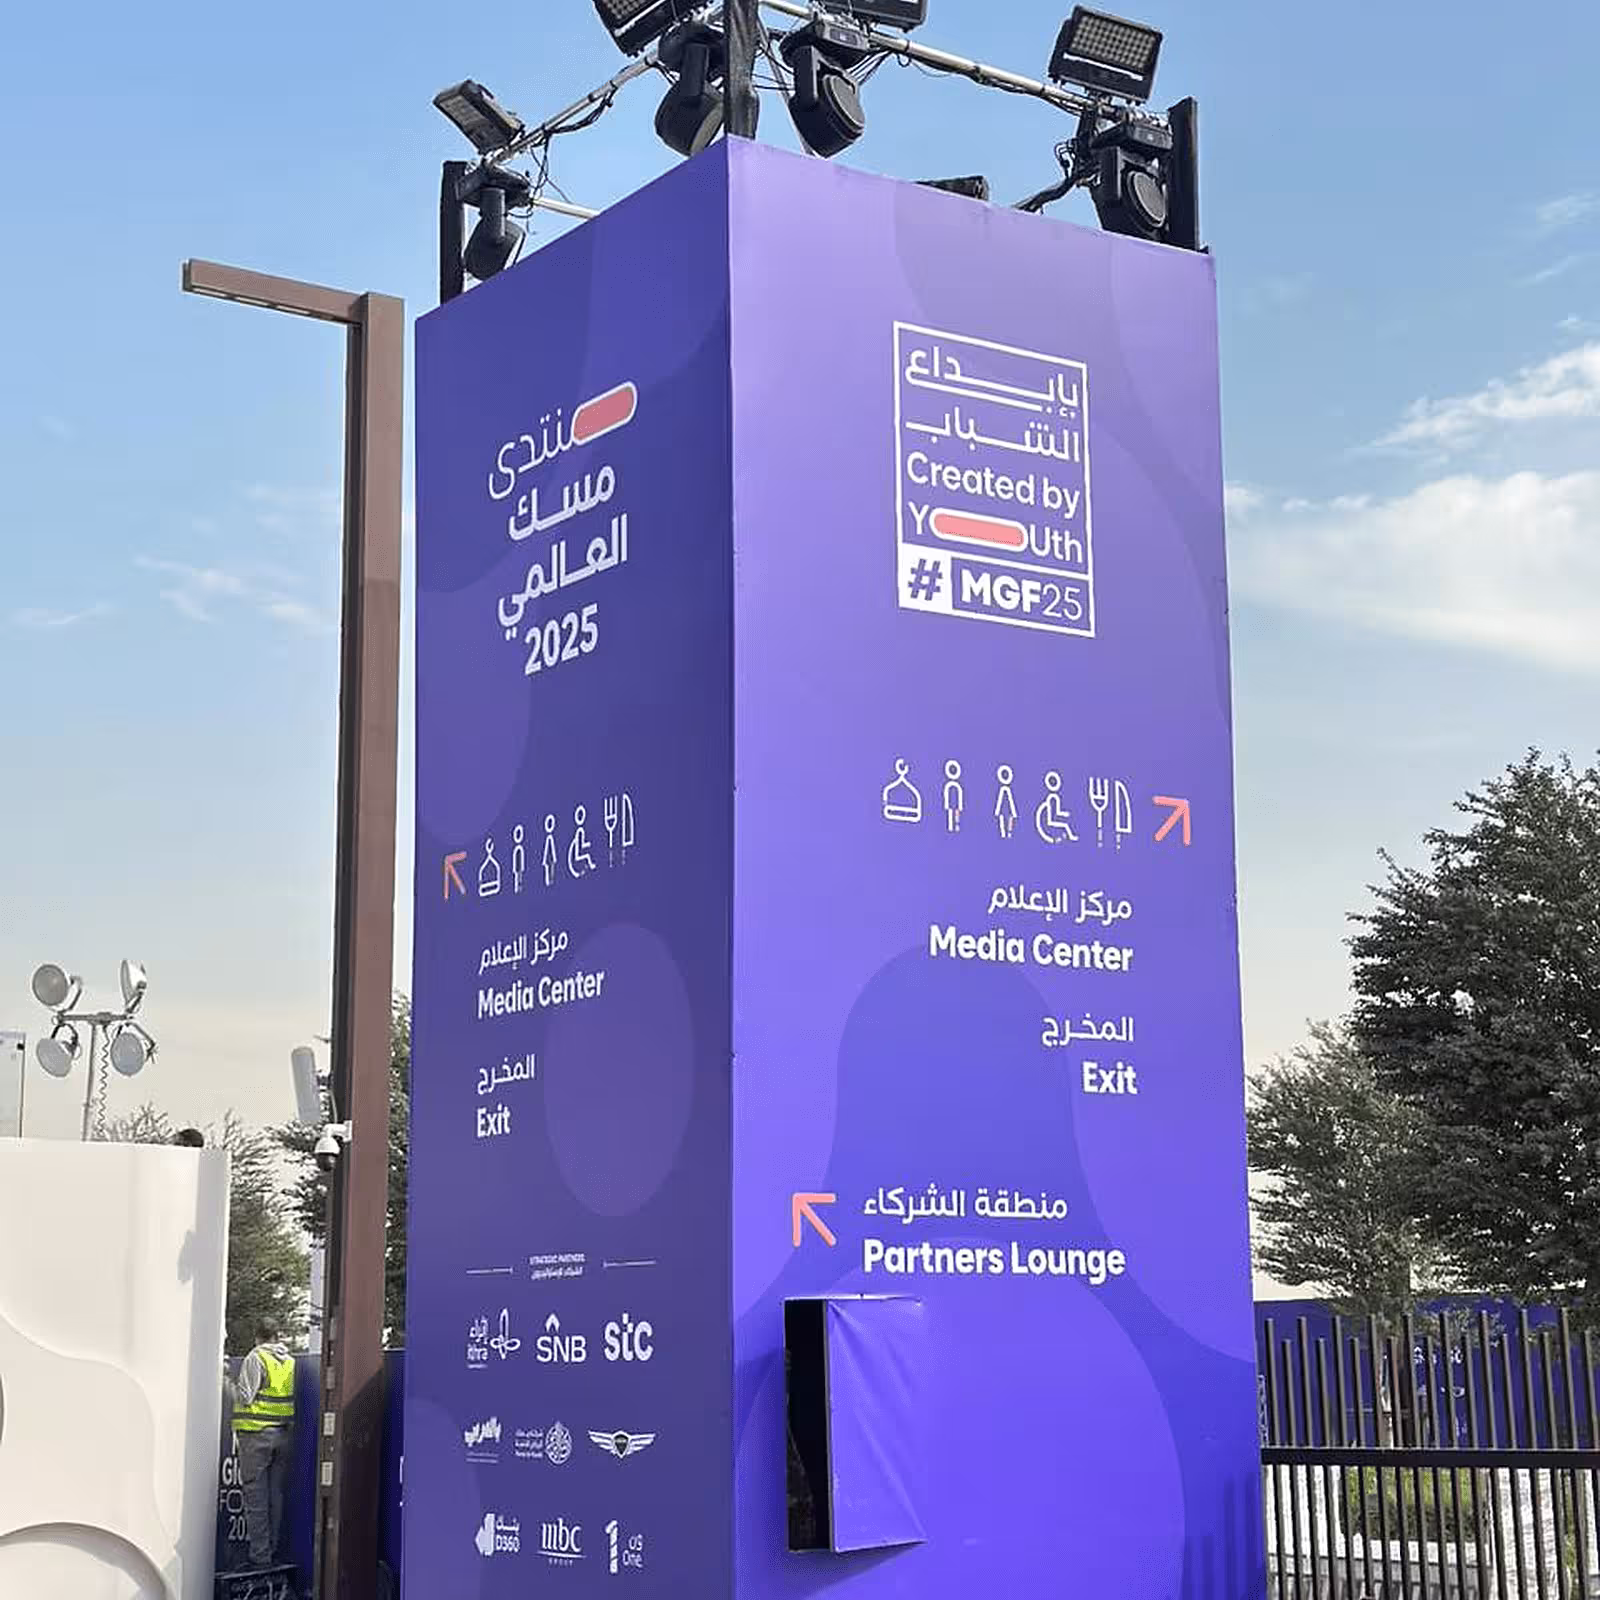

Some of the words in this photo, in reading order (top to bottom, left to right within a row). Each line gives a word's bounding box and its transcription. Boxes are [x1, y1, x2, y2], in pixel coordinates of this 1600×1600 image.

[906, 406, 1080, 463] الشباب
[508, 465, 615, 541] مسك
[906, 451, 1035, 505] Created
[1043, 477, 1080, 519] by
[498, 513, 628, 641] العالمي
[961, 569, 1082, 621] MGF25
[524, 603, 598, 676] 2025
[988, 885, 1068, 921] الإعلام
[1075, 890, 1132, 926] مركز
[478, 934, 527, 975] الإعلام
[530, 928, 568, 965] مركز
[929, 924, 1025, 964] Media
[1033, 933, 1134, 972] Center
[478, 980, 534, 1020] Media
[538, 971, 605, 1007] Center
[1042, 1013, 1134, 1047] المخرج
[477, 1053, 535, 1095] المخرج
[1082, 1061, 1138, 1095] Exit
[477, 1103, 511, 1138] Exit
[863, 1182, 966, 1224] الشركاء
[974, 1187, 1068, 1219] منطقة
[863, 1239, 1005, 1275] Partners
[1010, 1241, 1126, 1285] Lounge
[536, 1334, 587, 1363] SNB
